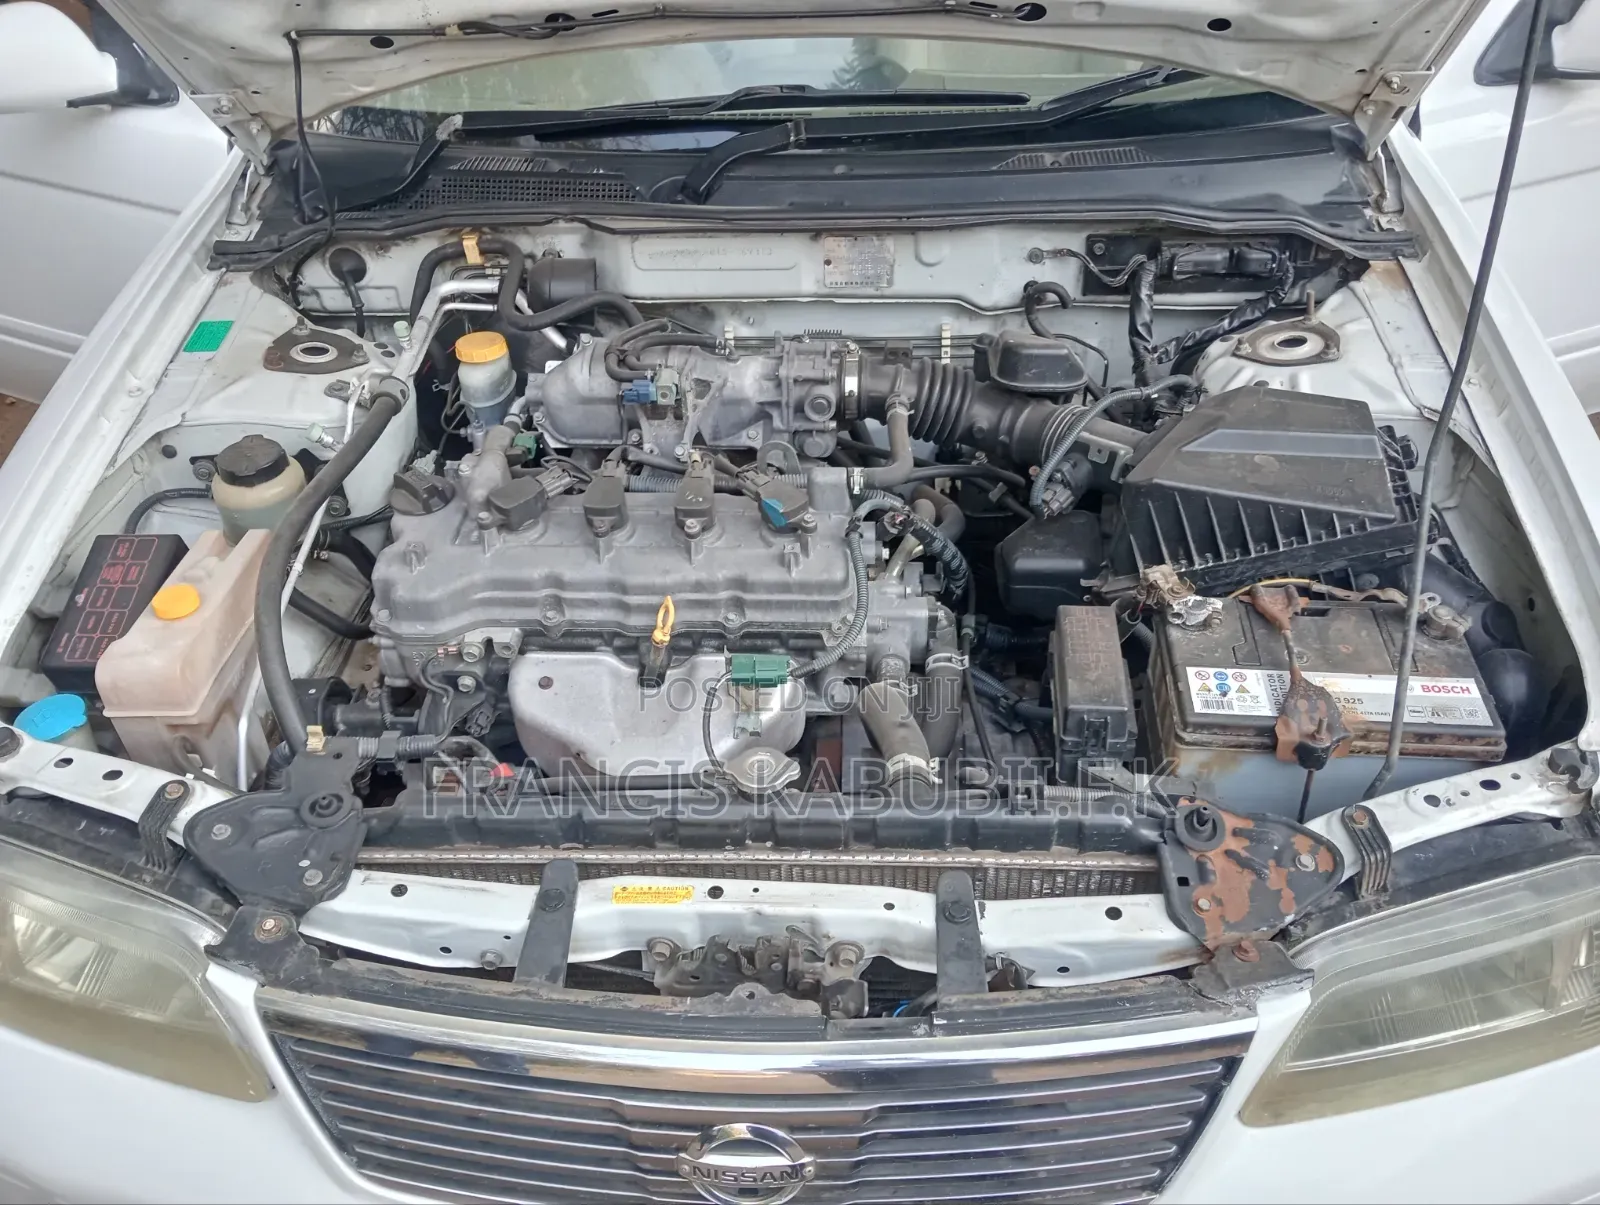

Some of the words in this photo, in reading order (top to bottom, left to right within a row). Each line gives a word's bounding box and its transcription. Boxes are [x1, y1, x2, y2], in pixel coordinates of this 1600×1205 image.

[1420, 684, 1472, 695] BOSCH
[1343, 697, 1364, 705] 925
[692, 1165, 799, 1184] NISSAN
